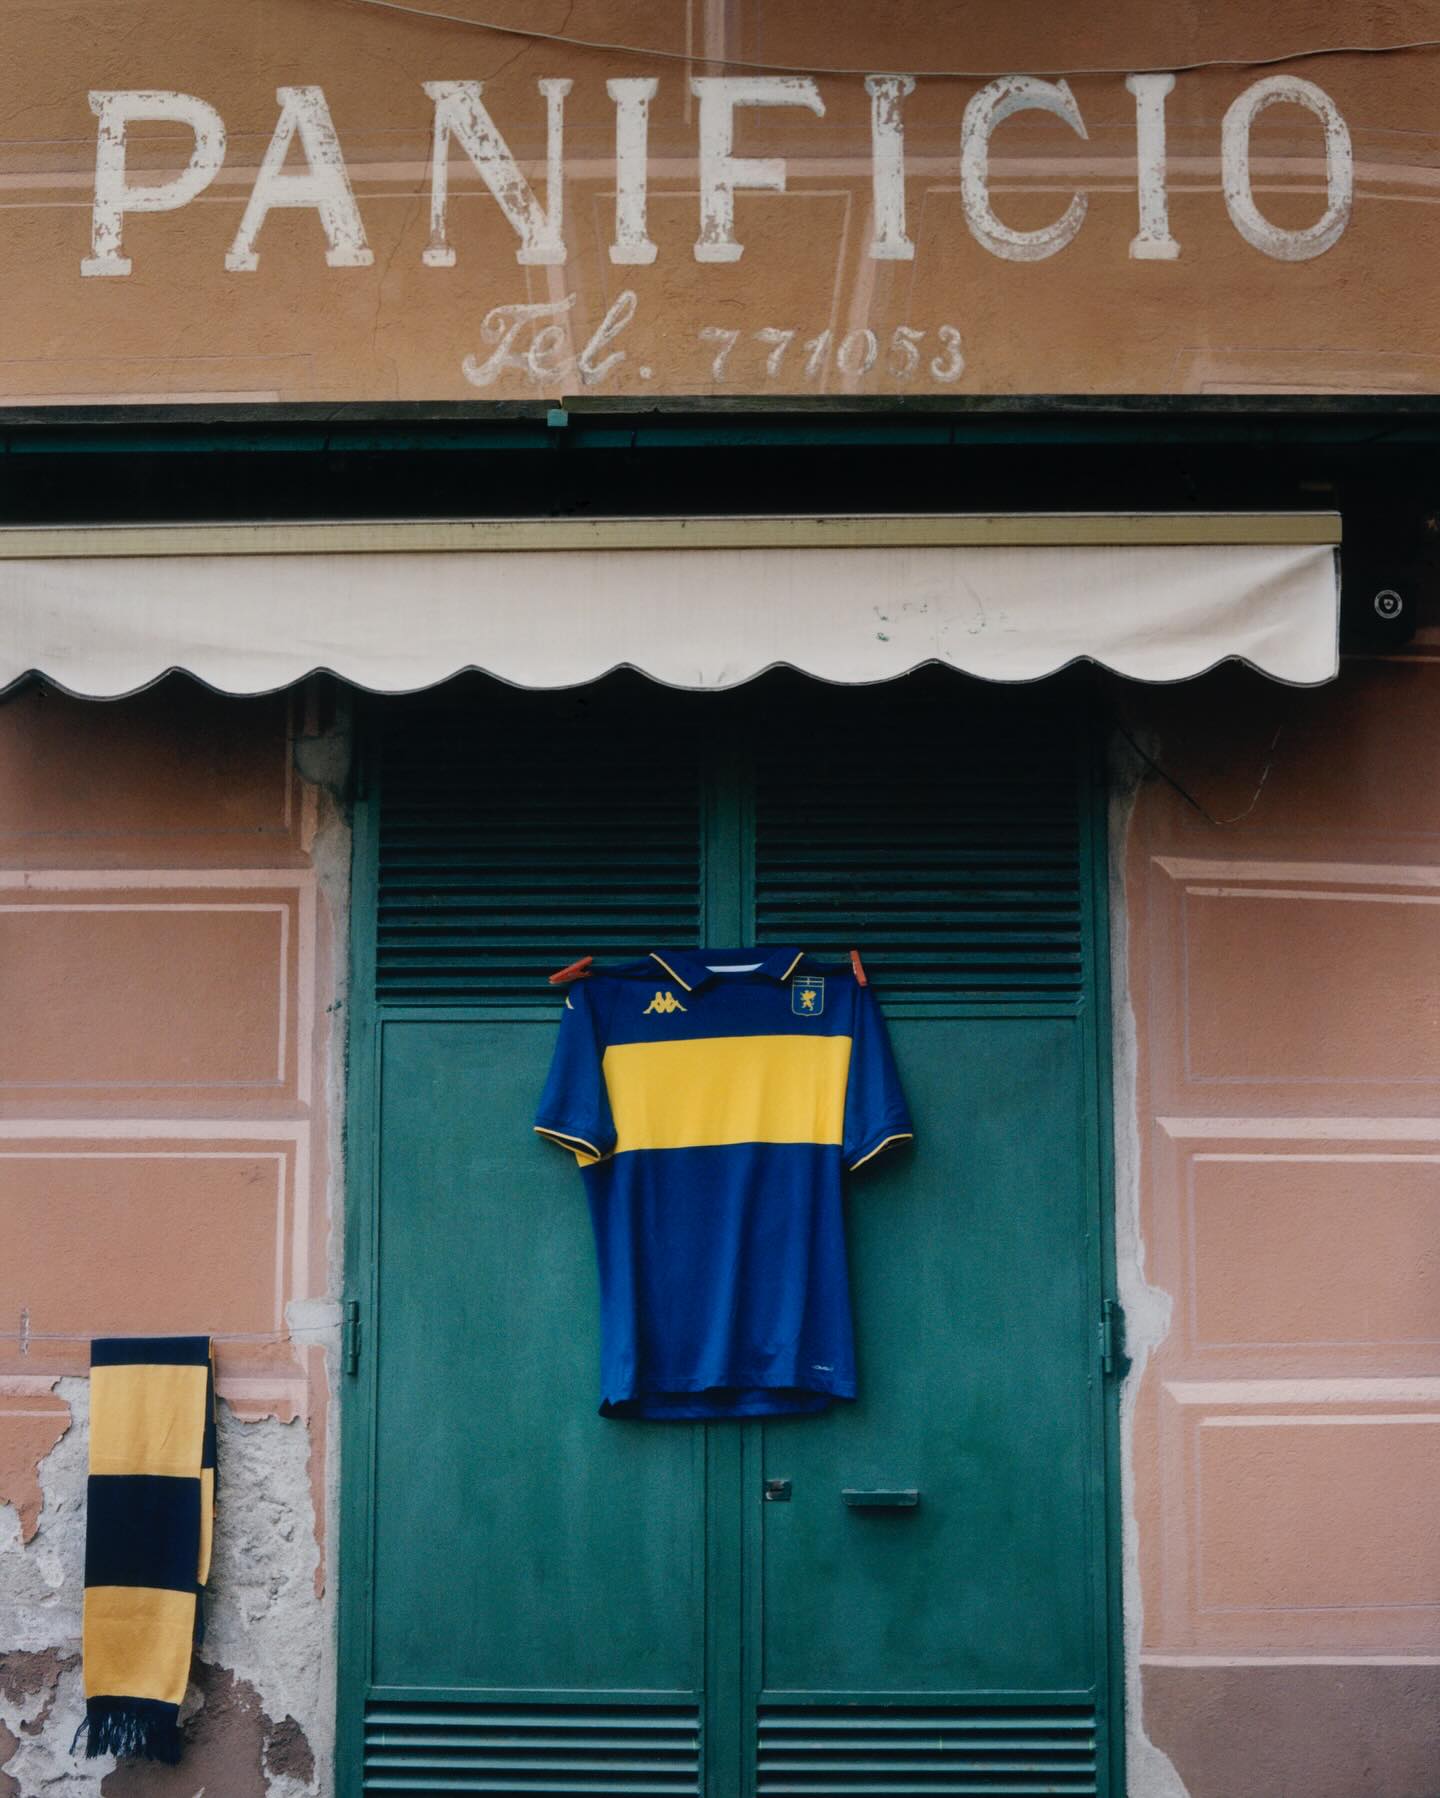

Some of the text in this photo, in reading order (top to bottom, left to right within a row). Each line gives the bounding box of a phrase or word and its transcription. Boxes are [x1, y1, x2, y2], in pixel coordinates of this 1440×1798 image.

[79, 74, 1355, 277] PANIFICIO
[461, 290, 964, 387] Tel. 771053
